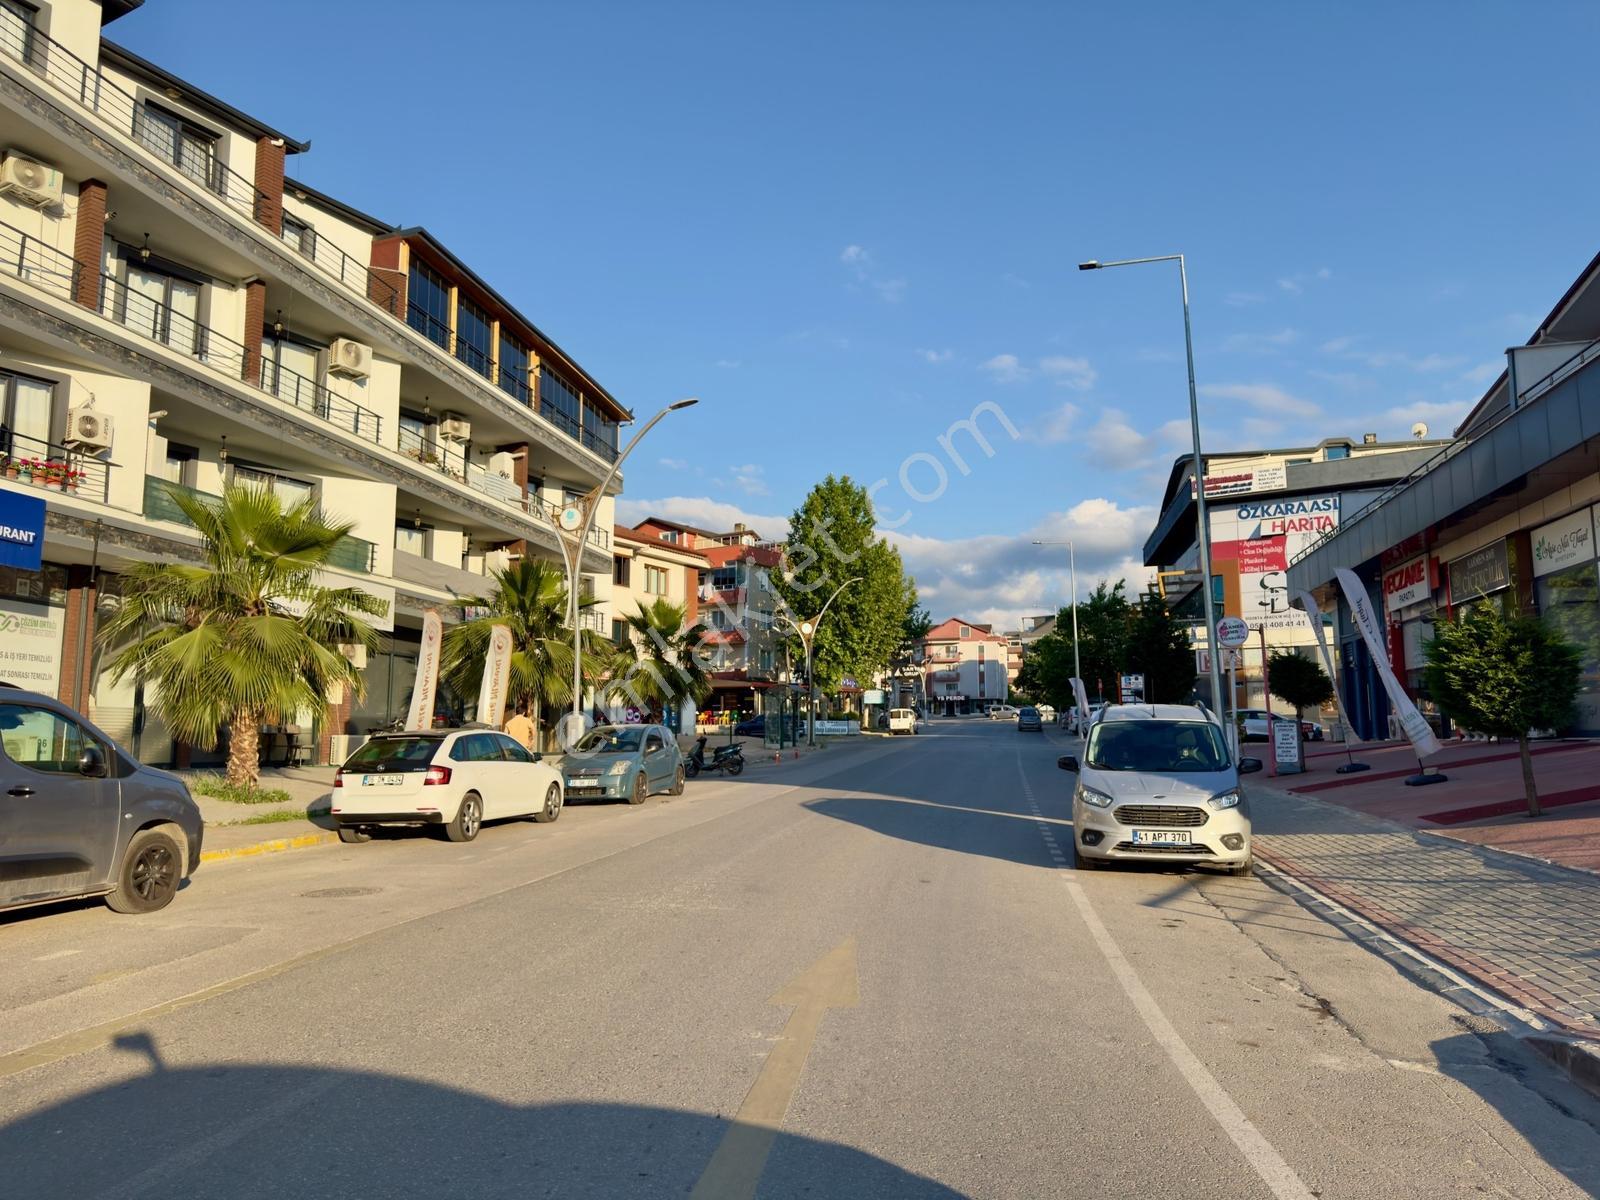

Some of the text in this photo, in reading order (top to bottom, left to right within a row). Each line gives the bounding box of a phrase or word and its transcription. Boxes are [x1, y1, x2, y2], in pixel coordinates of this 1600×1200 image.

[1271, 515, 1335, 533] HARİTA
[1249, 621, 1268, 629] 053
[1138, 832, 1187, 842] 41 APT 370
